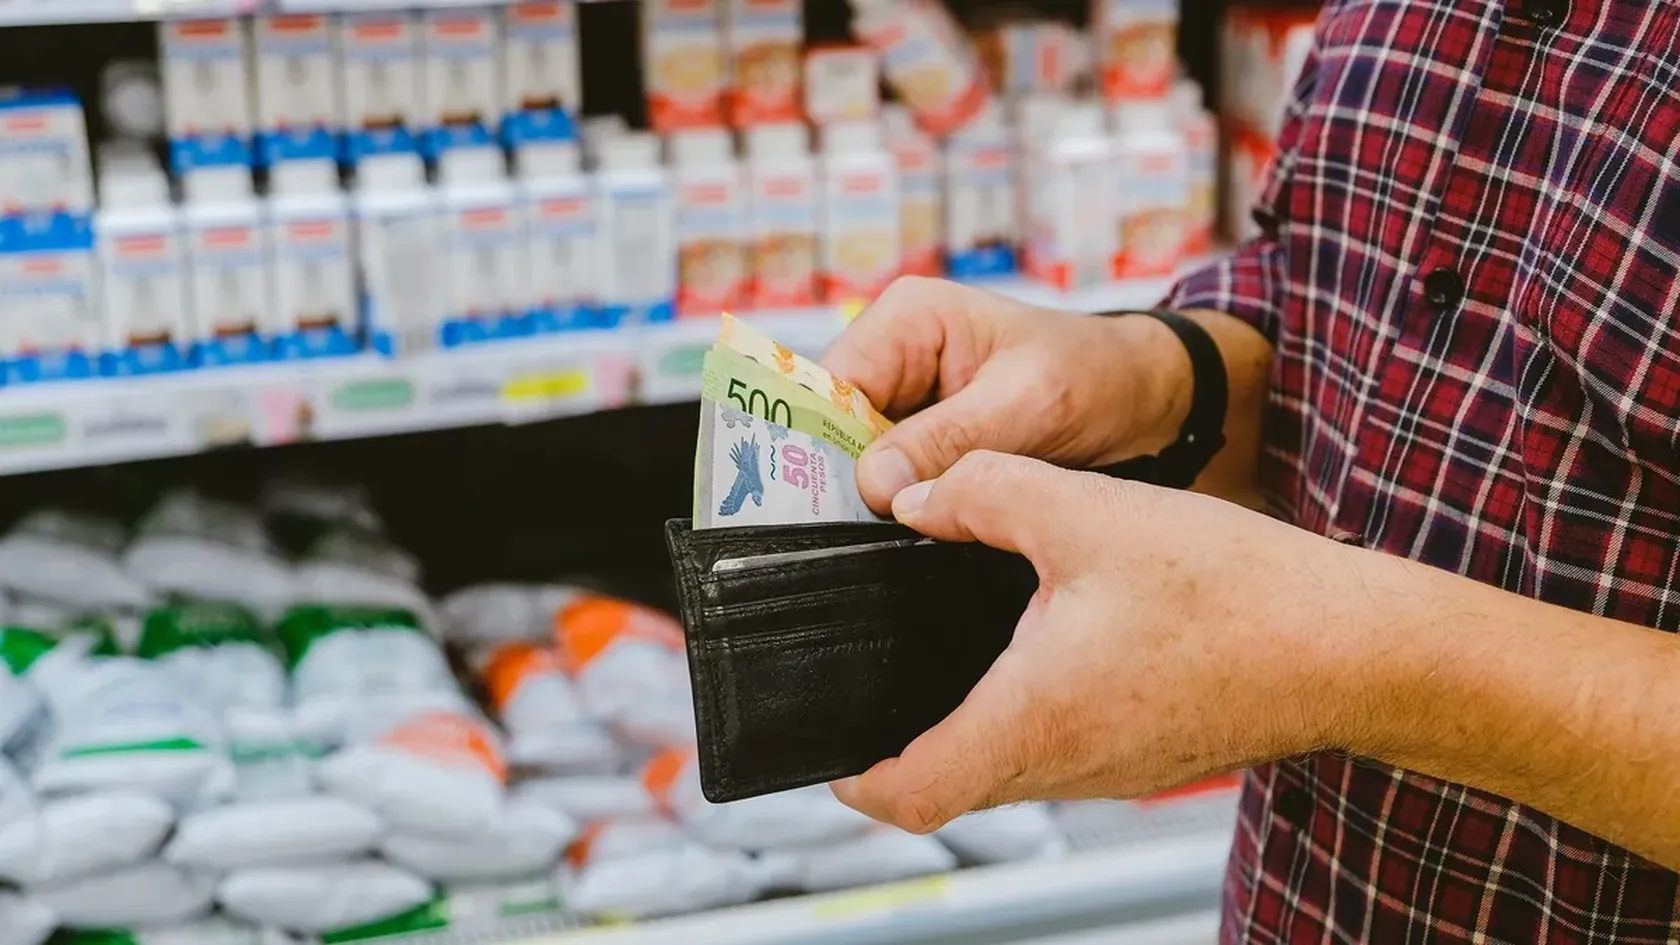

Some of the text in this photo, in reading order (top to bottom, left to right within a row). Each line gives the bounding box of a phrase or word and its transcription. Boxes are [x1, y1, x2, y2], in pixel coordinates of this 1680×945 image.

[727, 377, 792, 429] 500
[782, 444, 809, 490] 50
[810, 452, 820, 516] CINCUENTA
[817, 455, 827, 493] PESOS
